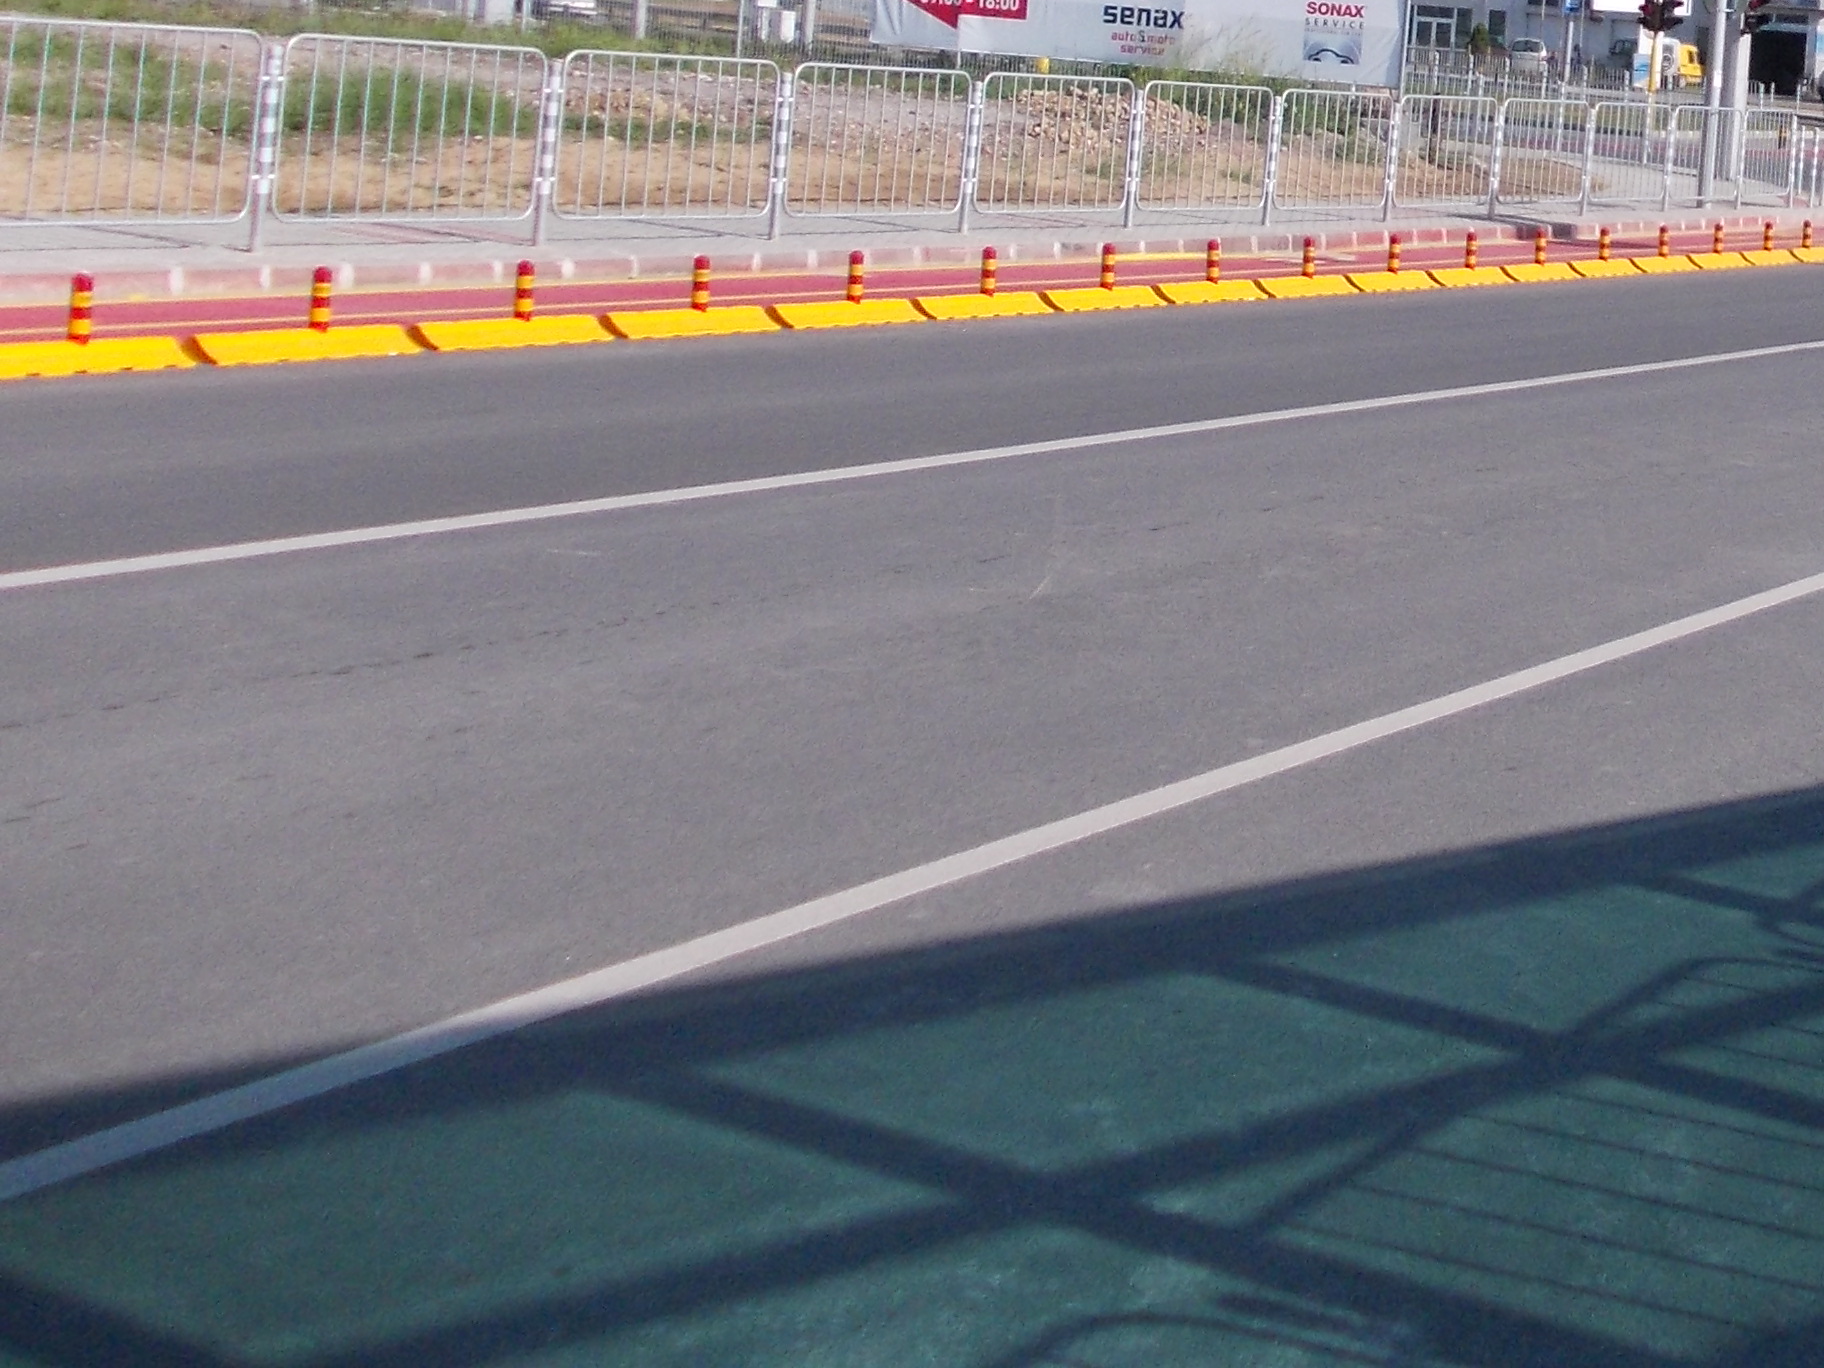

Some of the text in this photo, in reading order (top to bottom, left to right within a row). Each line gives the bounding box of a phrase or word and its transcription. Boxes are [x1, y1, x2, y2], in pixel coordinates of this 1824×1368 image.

[1103, 5, 1185, 29] senax
[1306, 1, 1365, 18] SONAX
[1305, 18, 1365, 30] SERVICE
